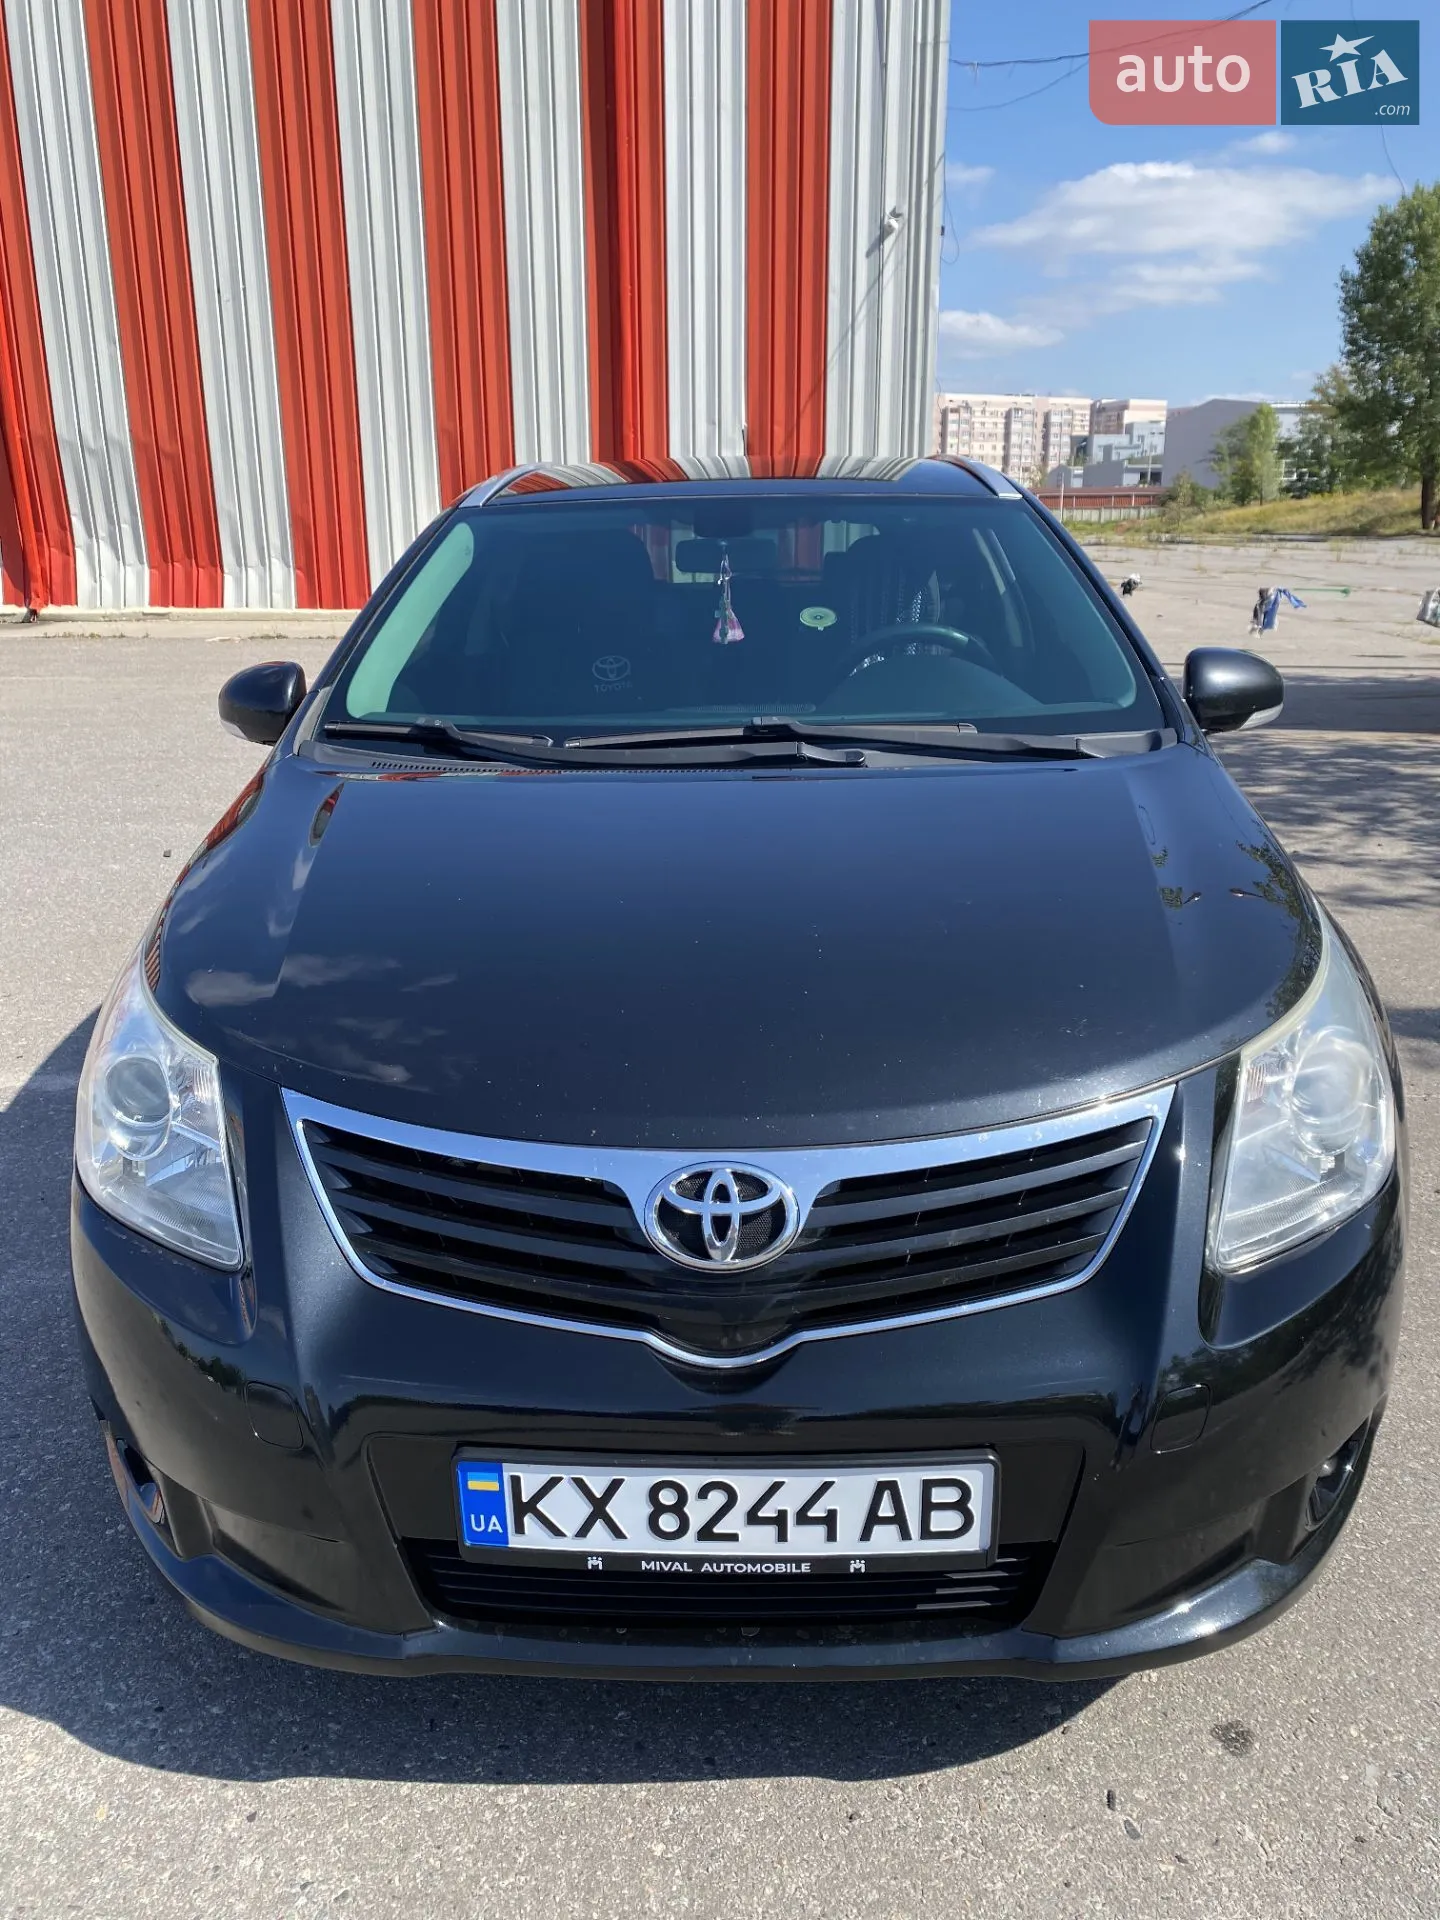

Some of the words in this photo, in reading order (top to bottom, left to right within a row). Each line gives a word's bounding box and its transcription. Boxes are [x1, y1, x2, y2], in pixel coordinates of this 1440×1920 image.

[510, 1475, 627, 1540] KX
[648, 1479, 838, 1542] 8244
[860, 1478, 975, 1541] AB
[471, 1514, 502, 1533] UA
[641, 1560, 693, 1573] MIVAL
[700, 1561, 811, 1574] AUTOMOBILE
